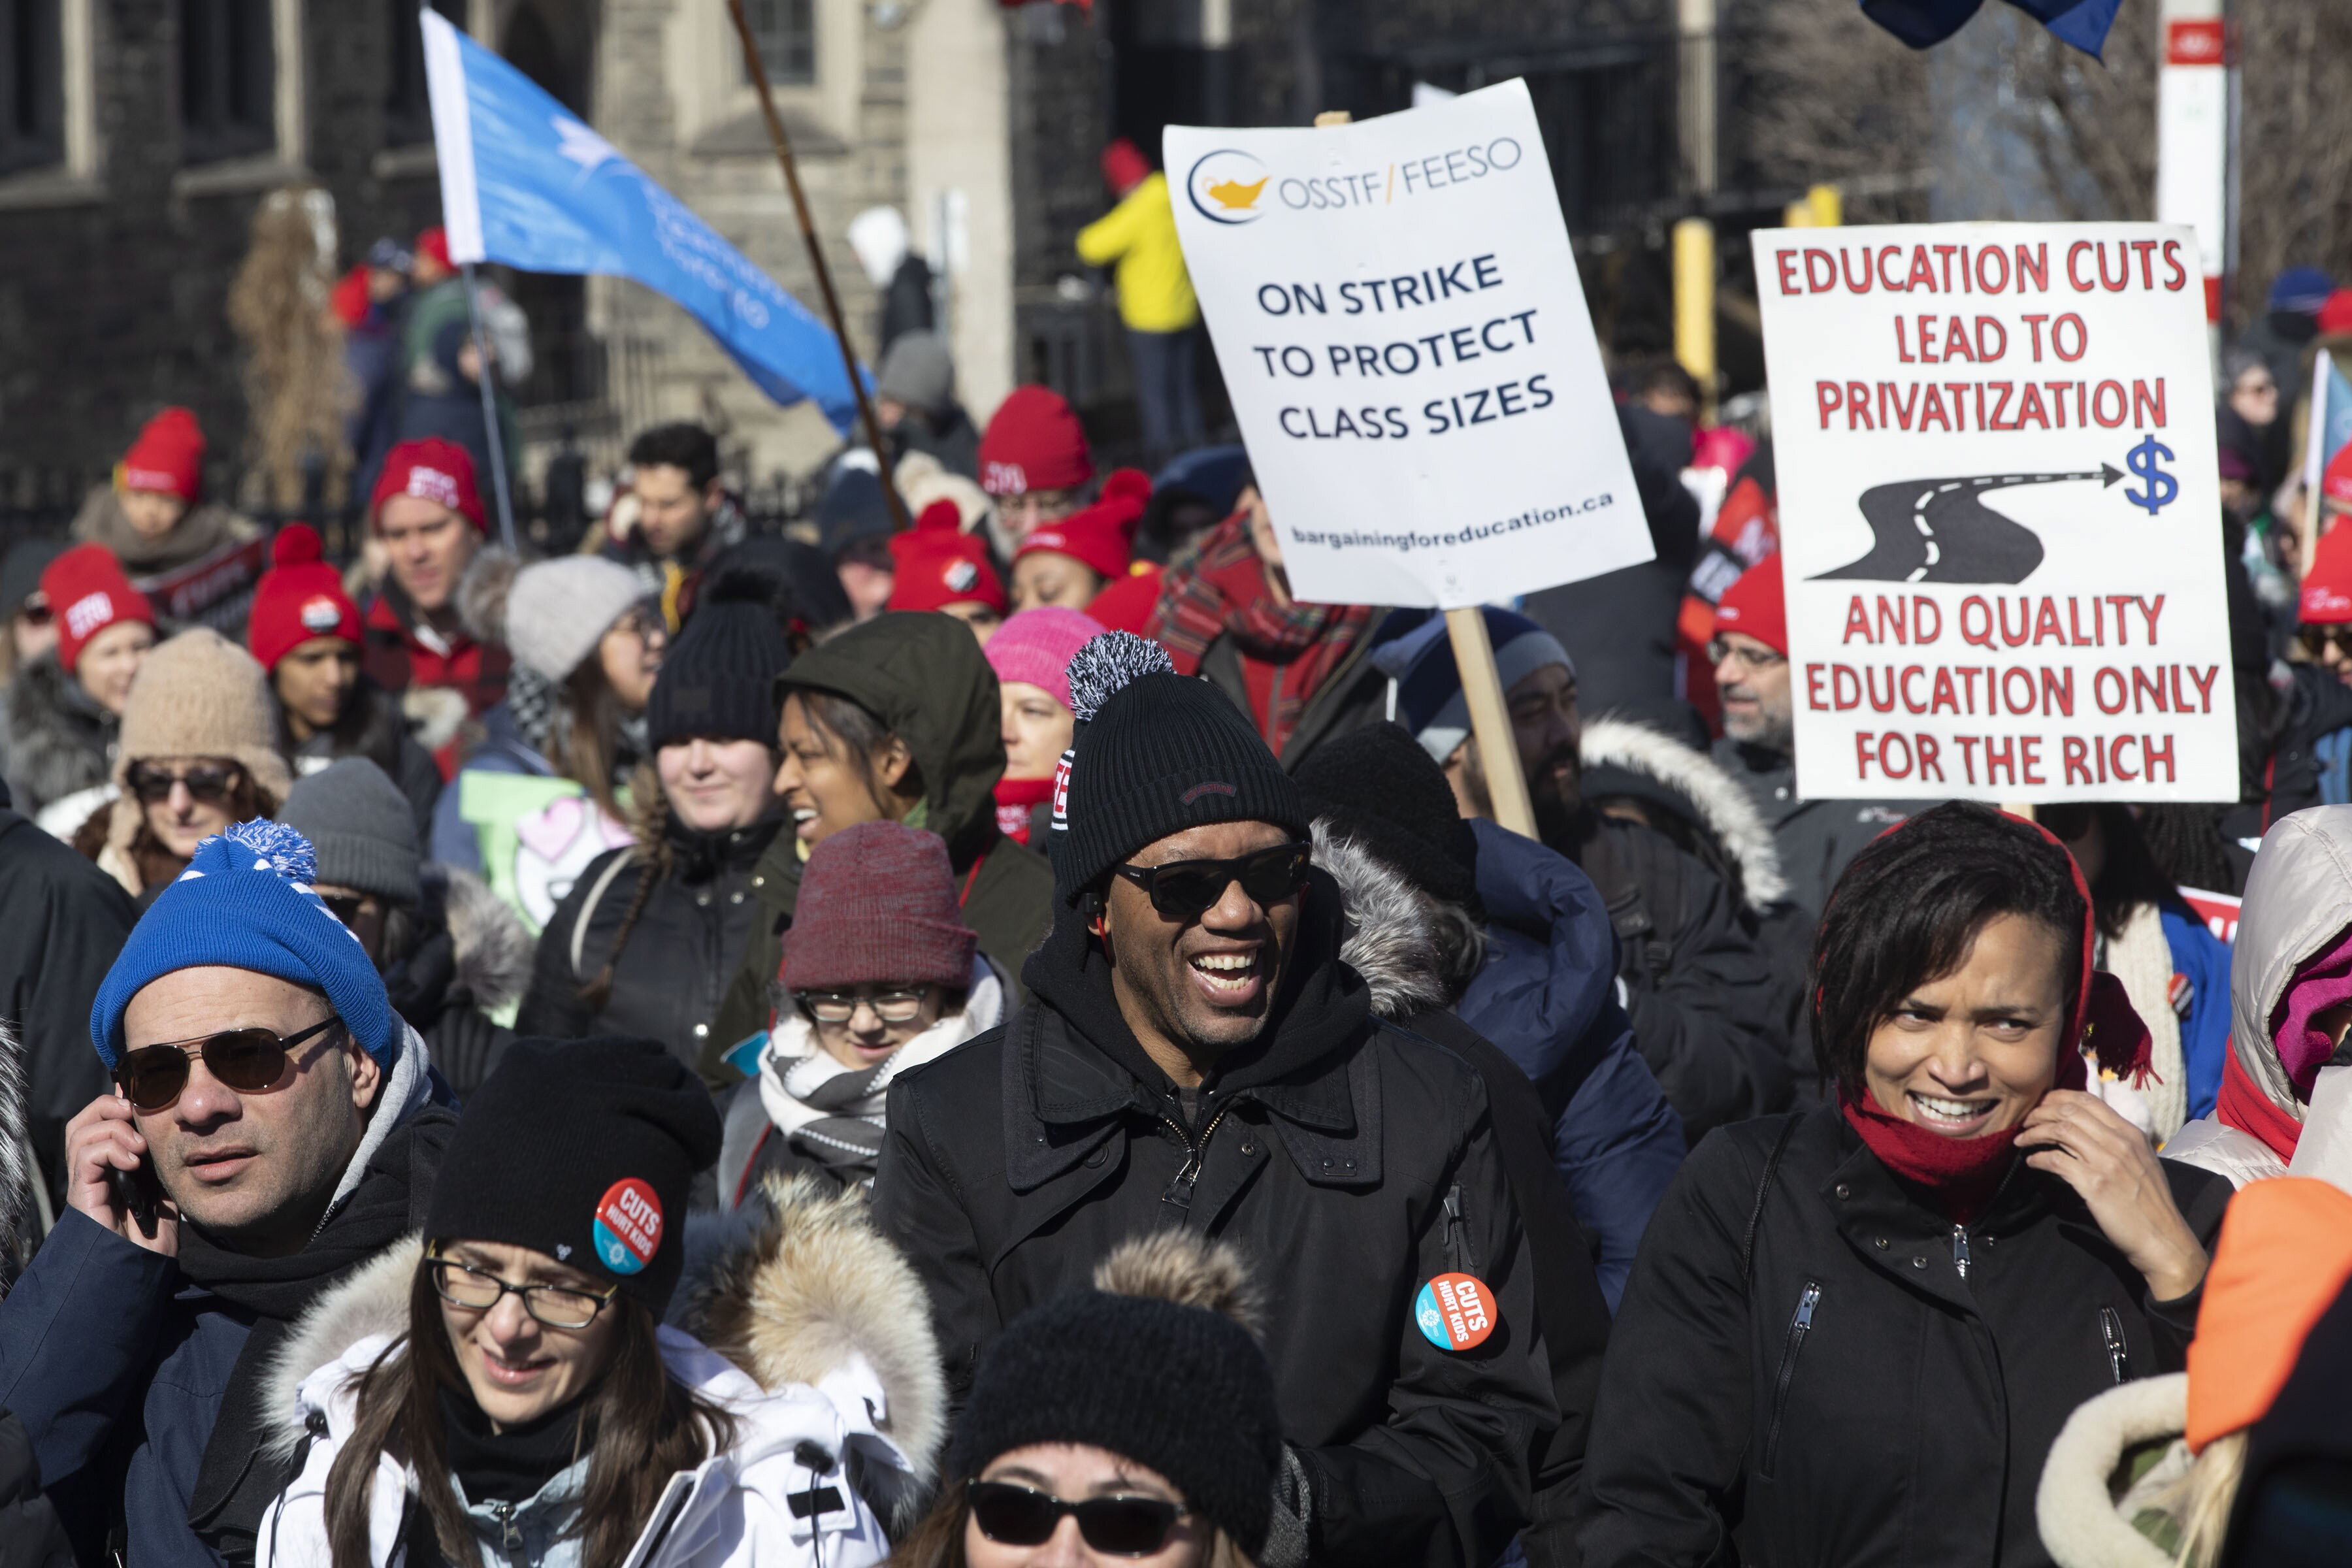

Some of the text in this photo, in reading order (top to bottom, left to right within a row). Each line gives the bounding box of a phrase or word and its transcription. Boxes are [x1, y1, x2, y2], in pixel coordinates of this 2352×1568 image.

[1279, 137, 1522, 210] OSSTF/FEESO
[1256, 253, 1505, 318] ON STRIKE
[1775, 239, 2187, 297] EDUCATION CUTS
[1251, 308, 1539, 379] TO PROTECT
[1894, 312, 2089, 364] LEAD TO
[1277, 373, 1555, 440] CLASS SIZES
[1816, 377, 2168, 433] PRIVATIZATION
[1290, 491, 1614, 553] bargainingforeducation.ca
[1842, 594, 2166, 652] AND QUALITY
[1805, 662, 2219, 718] EDUCATION ONLY
[1855, 730, 2177, 787] FOR THE RICH
[606, 1203, 653, 1257] HURT KIDS
[619, 1186, 661, 1236] CUTS
[1438, 1281, 1469, 1343] HURT KIDS
[1455, 1281, 1488, 1331] CUTS
